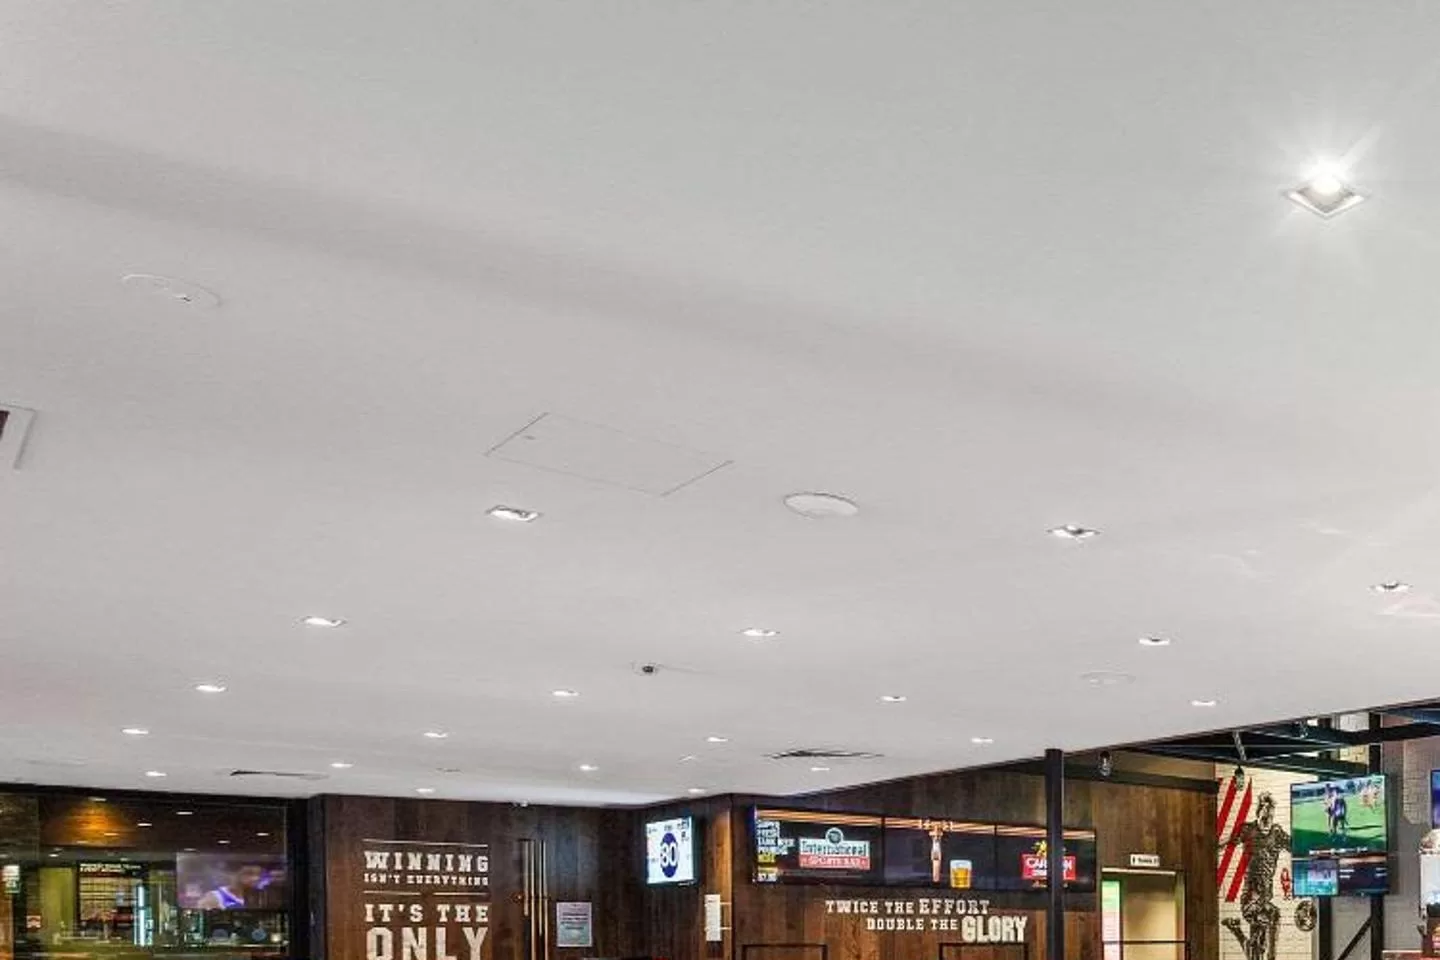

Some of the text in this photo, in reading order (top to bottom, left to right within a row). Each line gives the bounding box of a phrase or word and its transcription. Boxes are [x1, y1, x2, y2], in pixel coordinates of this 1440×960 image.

[364, 851, 489, 872] WINNING
[364, 873, 489, 886] ISN'T EVERYTHING
[365, 904, 489, 922] IT'S THE
[825, 898, 990, 915] TWICE THE EFFORT
[867, 915, 1028, 943] DOUBLE THE GLORY
